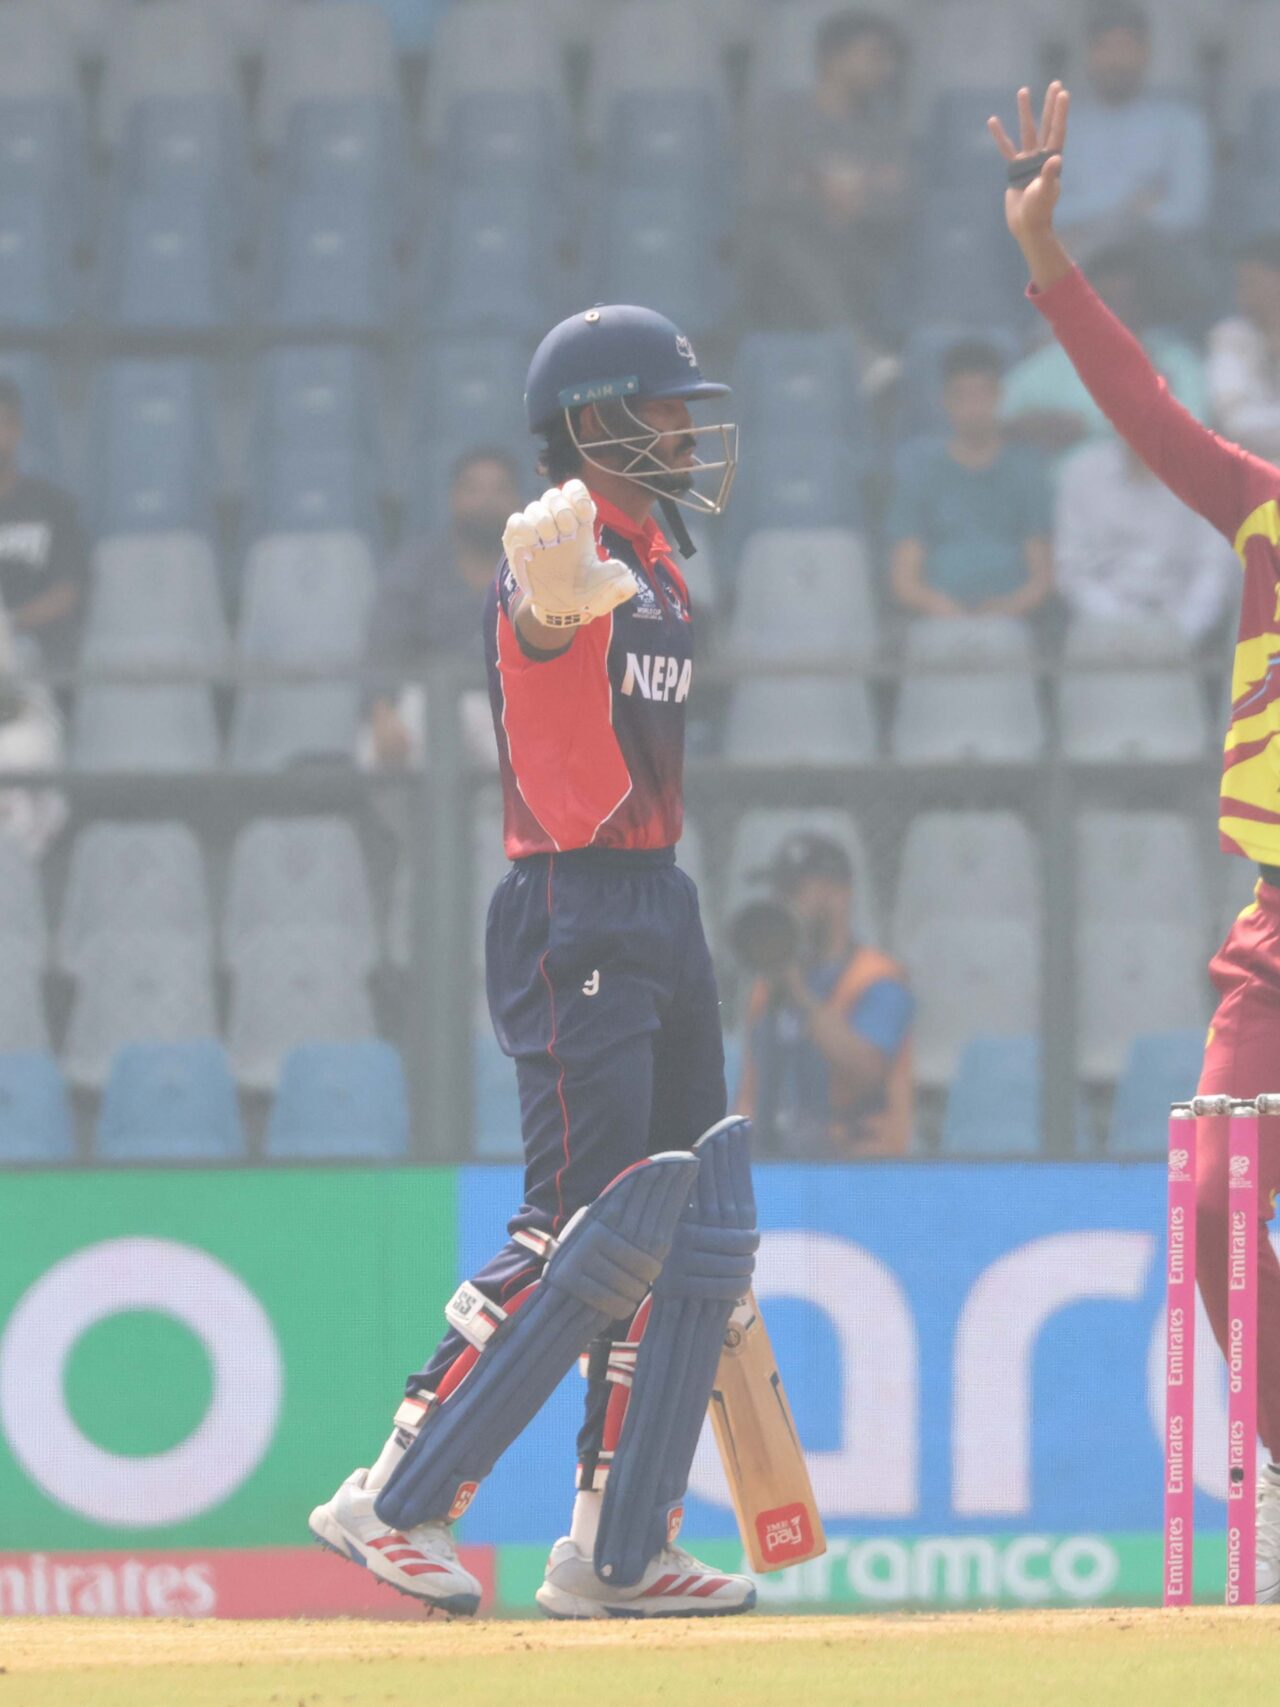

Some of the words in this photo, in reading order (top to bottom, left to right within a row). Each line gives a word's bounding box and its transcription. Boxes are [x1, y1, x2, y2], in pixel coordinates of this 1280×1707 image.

[1168, 1206, 1184, 1285] Emirates
[1230, 1211, 1246, 1291] Emirates
[1168, 1307, 1184, 1386] Emirates
[1230, 1318, 1243, 1393] aramco
[1168, 1415, 1183, 1494] Emirates
[1229, 1420, 1244, 1500] Eirates
[766, 1524, 803, 1552] pay
[1167, 1517, 1183, 1596] Emirates
[1228, 1527, 1240, 1603] aramco
